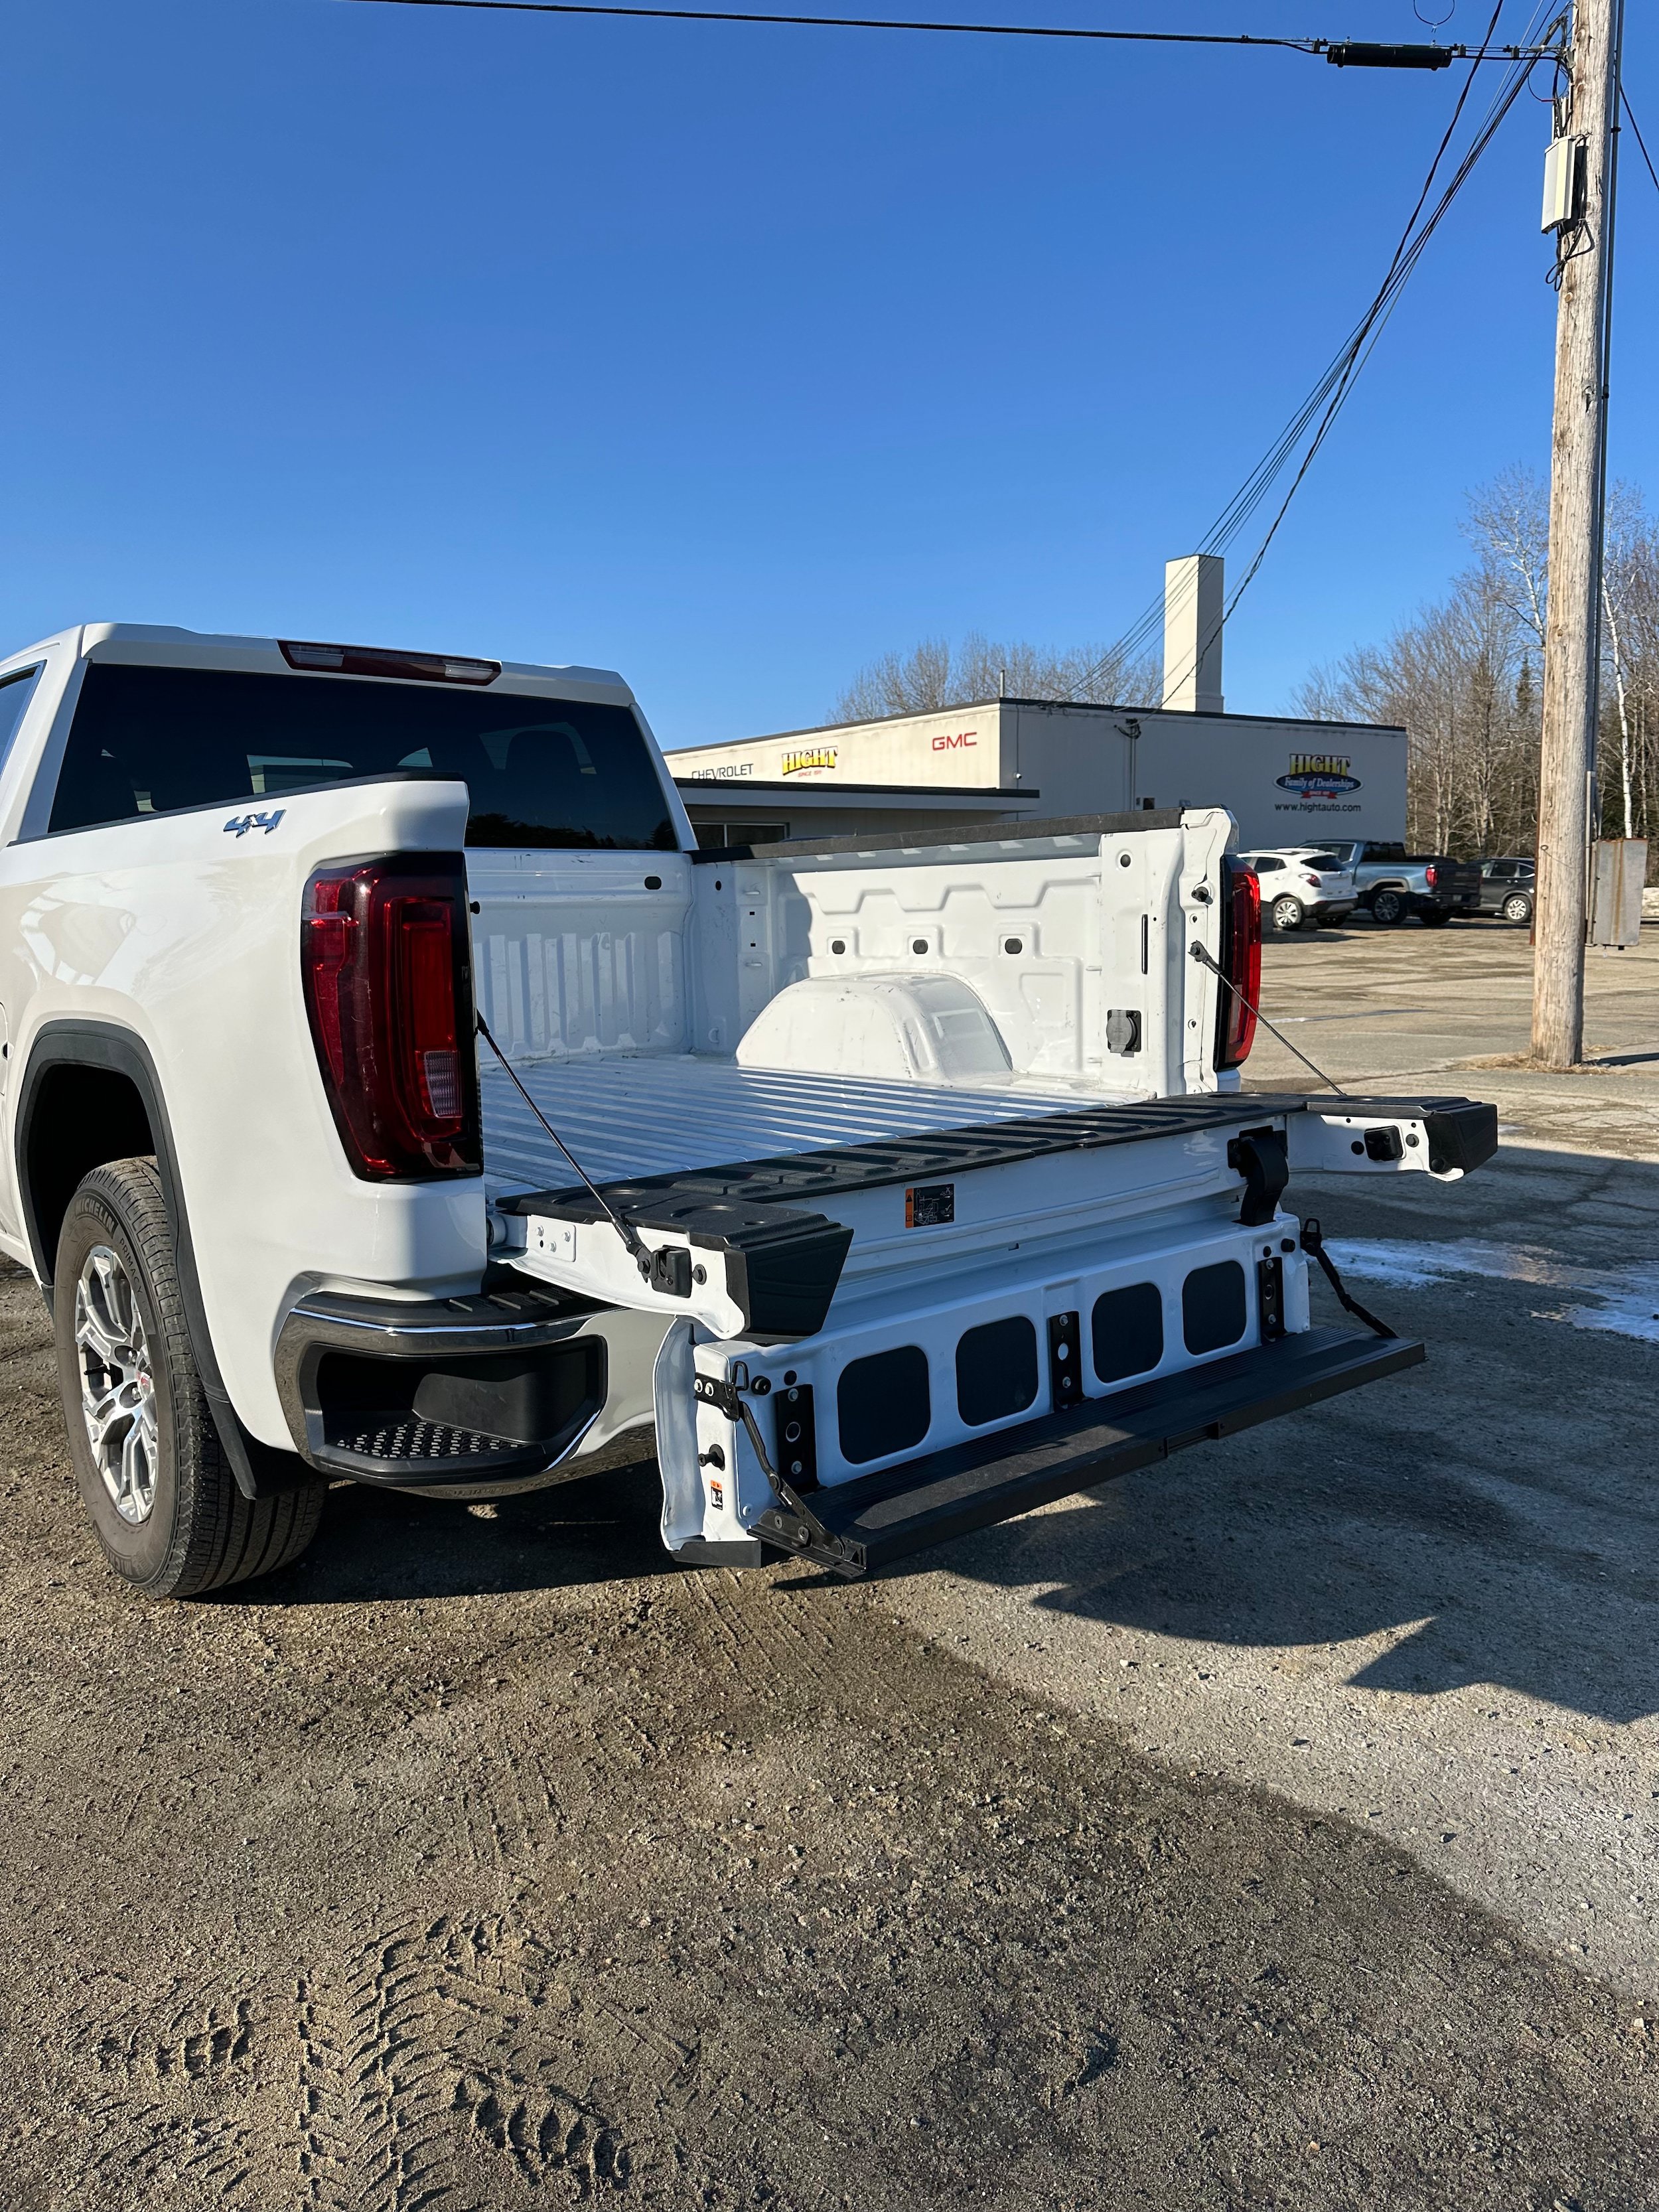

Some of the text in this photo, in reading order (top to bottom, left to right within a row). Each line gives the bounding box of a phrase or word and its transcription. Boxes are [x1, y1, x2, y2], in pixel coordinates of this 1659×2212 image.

[932, 732, 977, 751] GMC
[782, 745, 838, 776] HIGHT
[1289, 753, 1350, 776] HIGHT
[692, 763, 753, 780] CHEVROLET
[1285, 777, 1354, 789] Family of Dealerships
[1275, 802, 1361, 813] www.hightauto.com
[75, 1198, 117, 1234] MICHELIN
[119, 1238, 143, 1293] PRIMACY
